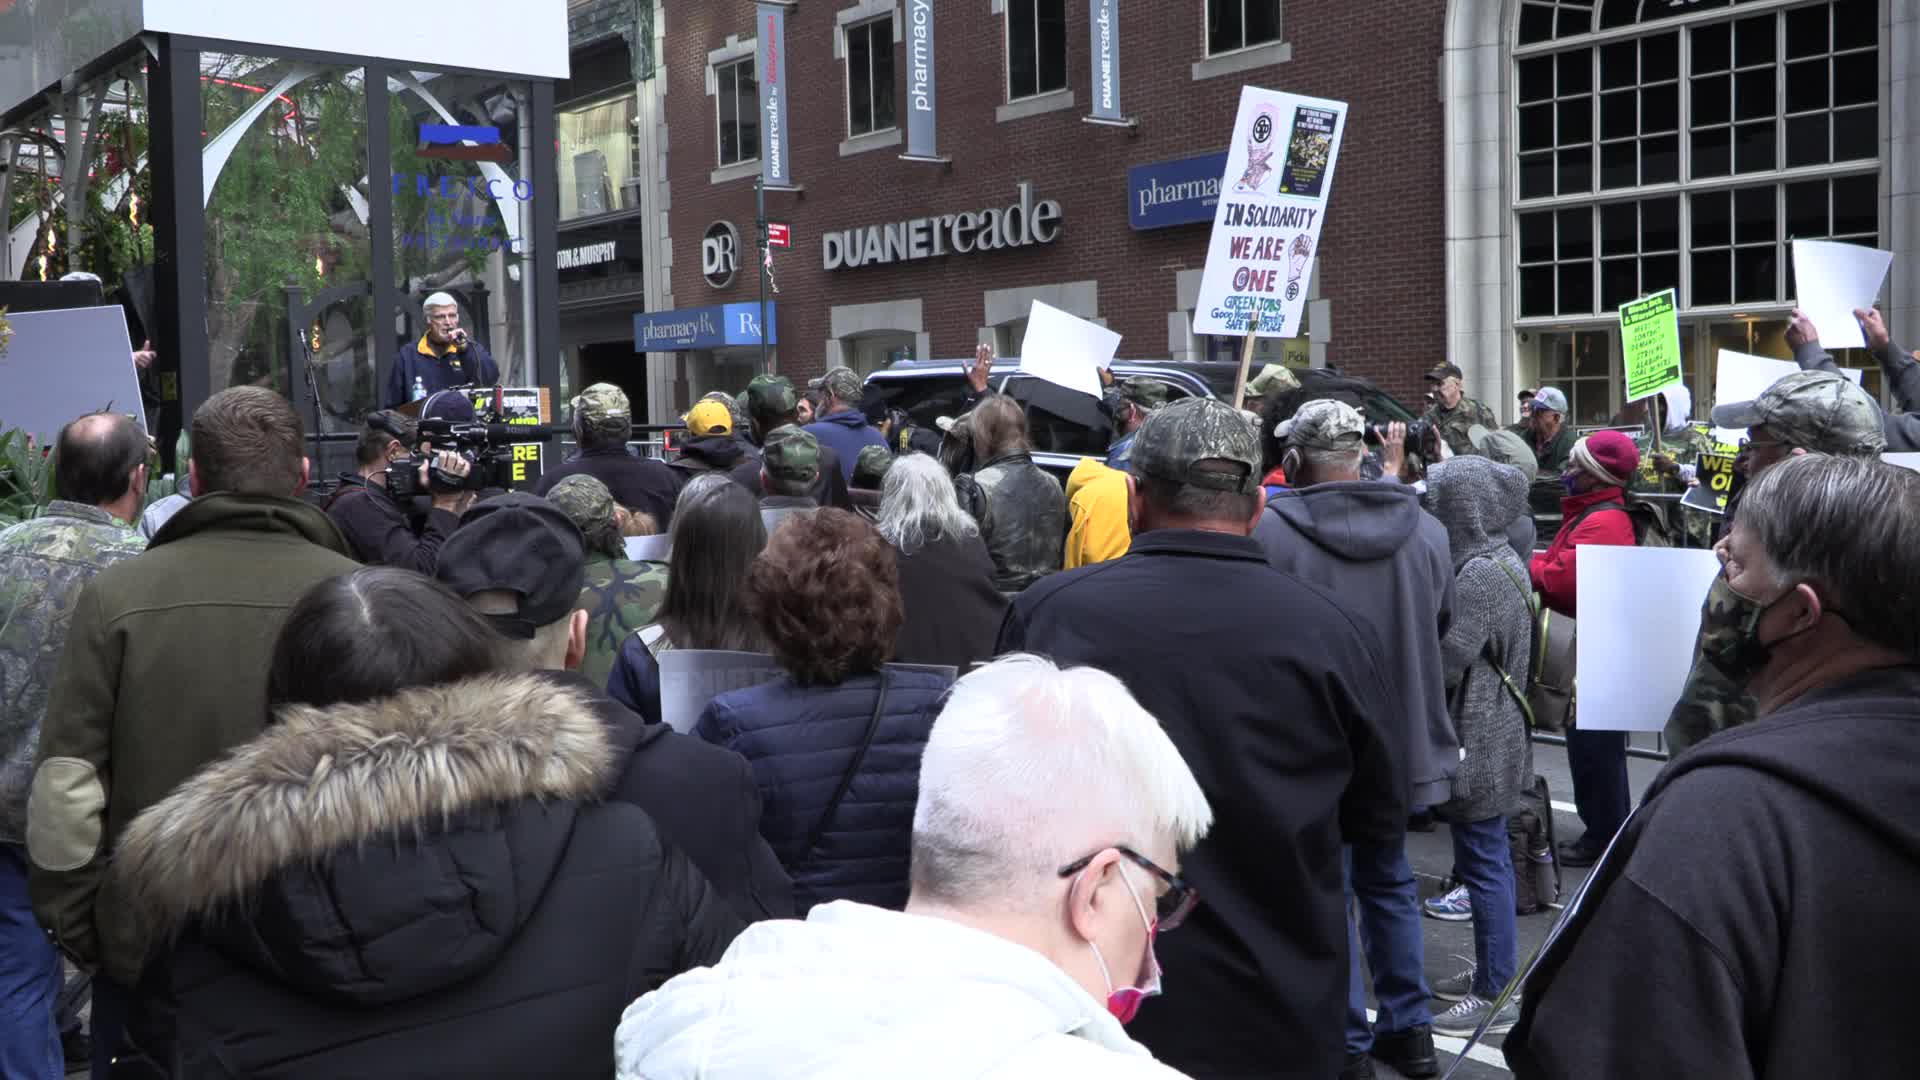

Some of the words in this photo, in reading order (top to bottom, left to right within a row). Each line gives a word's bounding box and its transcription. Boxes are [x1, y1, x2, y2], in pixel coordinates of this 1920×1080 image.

[912, 0, 931, 111] pharmacy
[391, 174, 533, 201] FRESCO
[1224, 203, 1245, 226] IN
[1245, 203, 1317, 230] SOLIDARITY
[1229, 236, 1253, 260] WE
[1252, 236, 1285, 261] ARE
[1232, 266, 1277, 292] ONE
[1224, 295, 1256, 310] GREEN
[643, 320, 698, 347] pharmacy
[1244, 320, 1282, 332] WKPLACE
[503, 396, 537, 407] STRIKE
[513, 445, 538, 461] RE
[1702, 456, 1735, 473] WE
